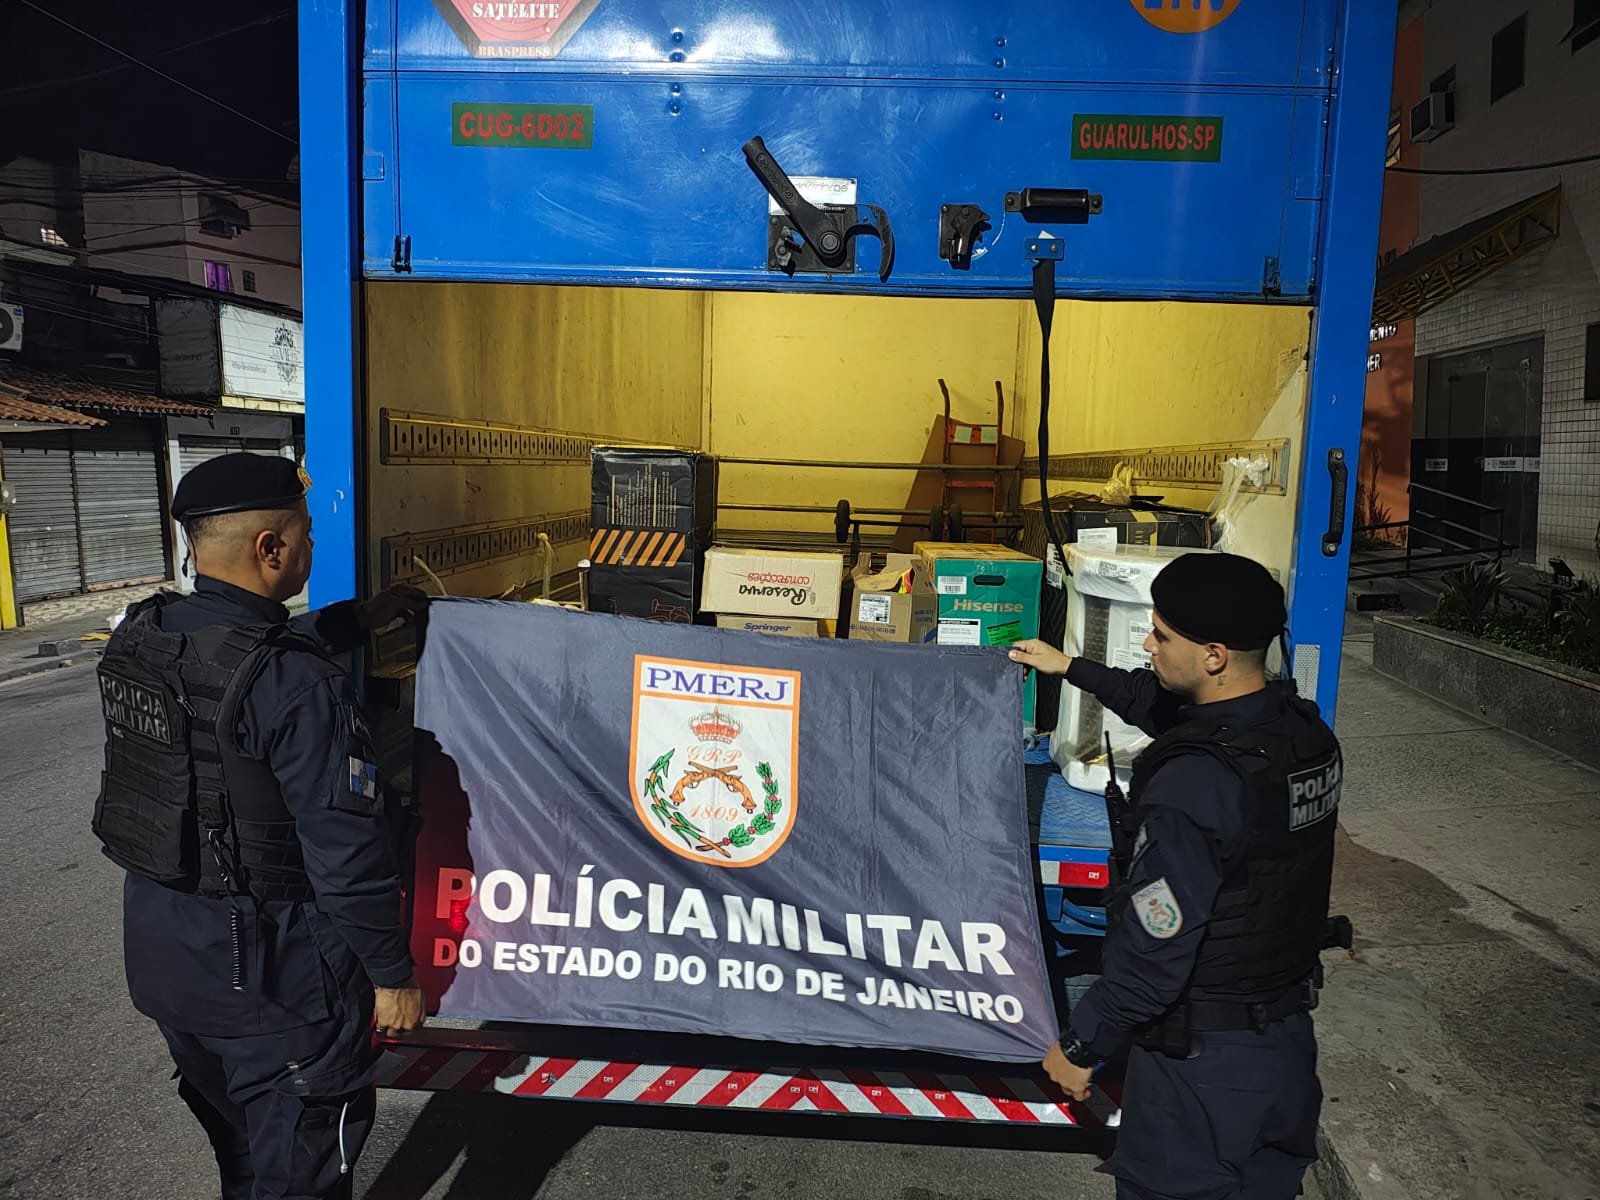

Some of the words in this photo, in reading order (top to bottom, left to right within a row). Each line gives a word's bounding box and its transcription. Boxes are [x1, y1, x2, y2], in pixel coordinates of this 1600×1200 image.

[472, 0, 560, 20] SATÉLITE
[479, 46, 551, 57] BRASPRESS
[459, 112, 584, 140] CUG-6D02
[1079, 122, 1215, 151] GUARULHOS-SP
[738, 584, 807, 606] Reserva
[953, 598, 1024, 613] Hisense
[743, 622, 792, 632] Springer
[646, 667, 788, 701] PMERJ
[104, 698, 167, 741] MILITAR
[689, 804, 739, 822] 1809
[435, 864, 718, 939] POLÍCIA
[722, 894, 1015, 976] MILITAR
[432, 938, 482, 968] DO
[493, 941, 642, 980] ESTADO
[654, 953, 707, 985] DO
[718, 958, 784, 992] RIO
[796, 968, 846, 1002] DE
[856, 976, 1024, 1024] JANEIRO
